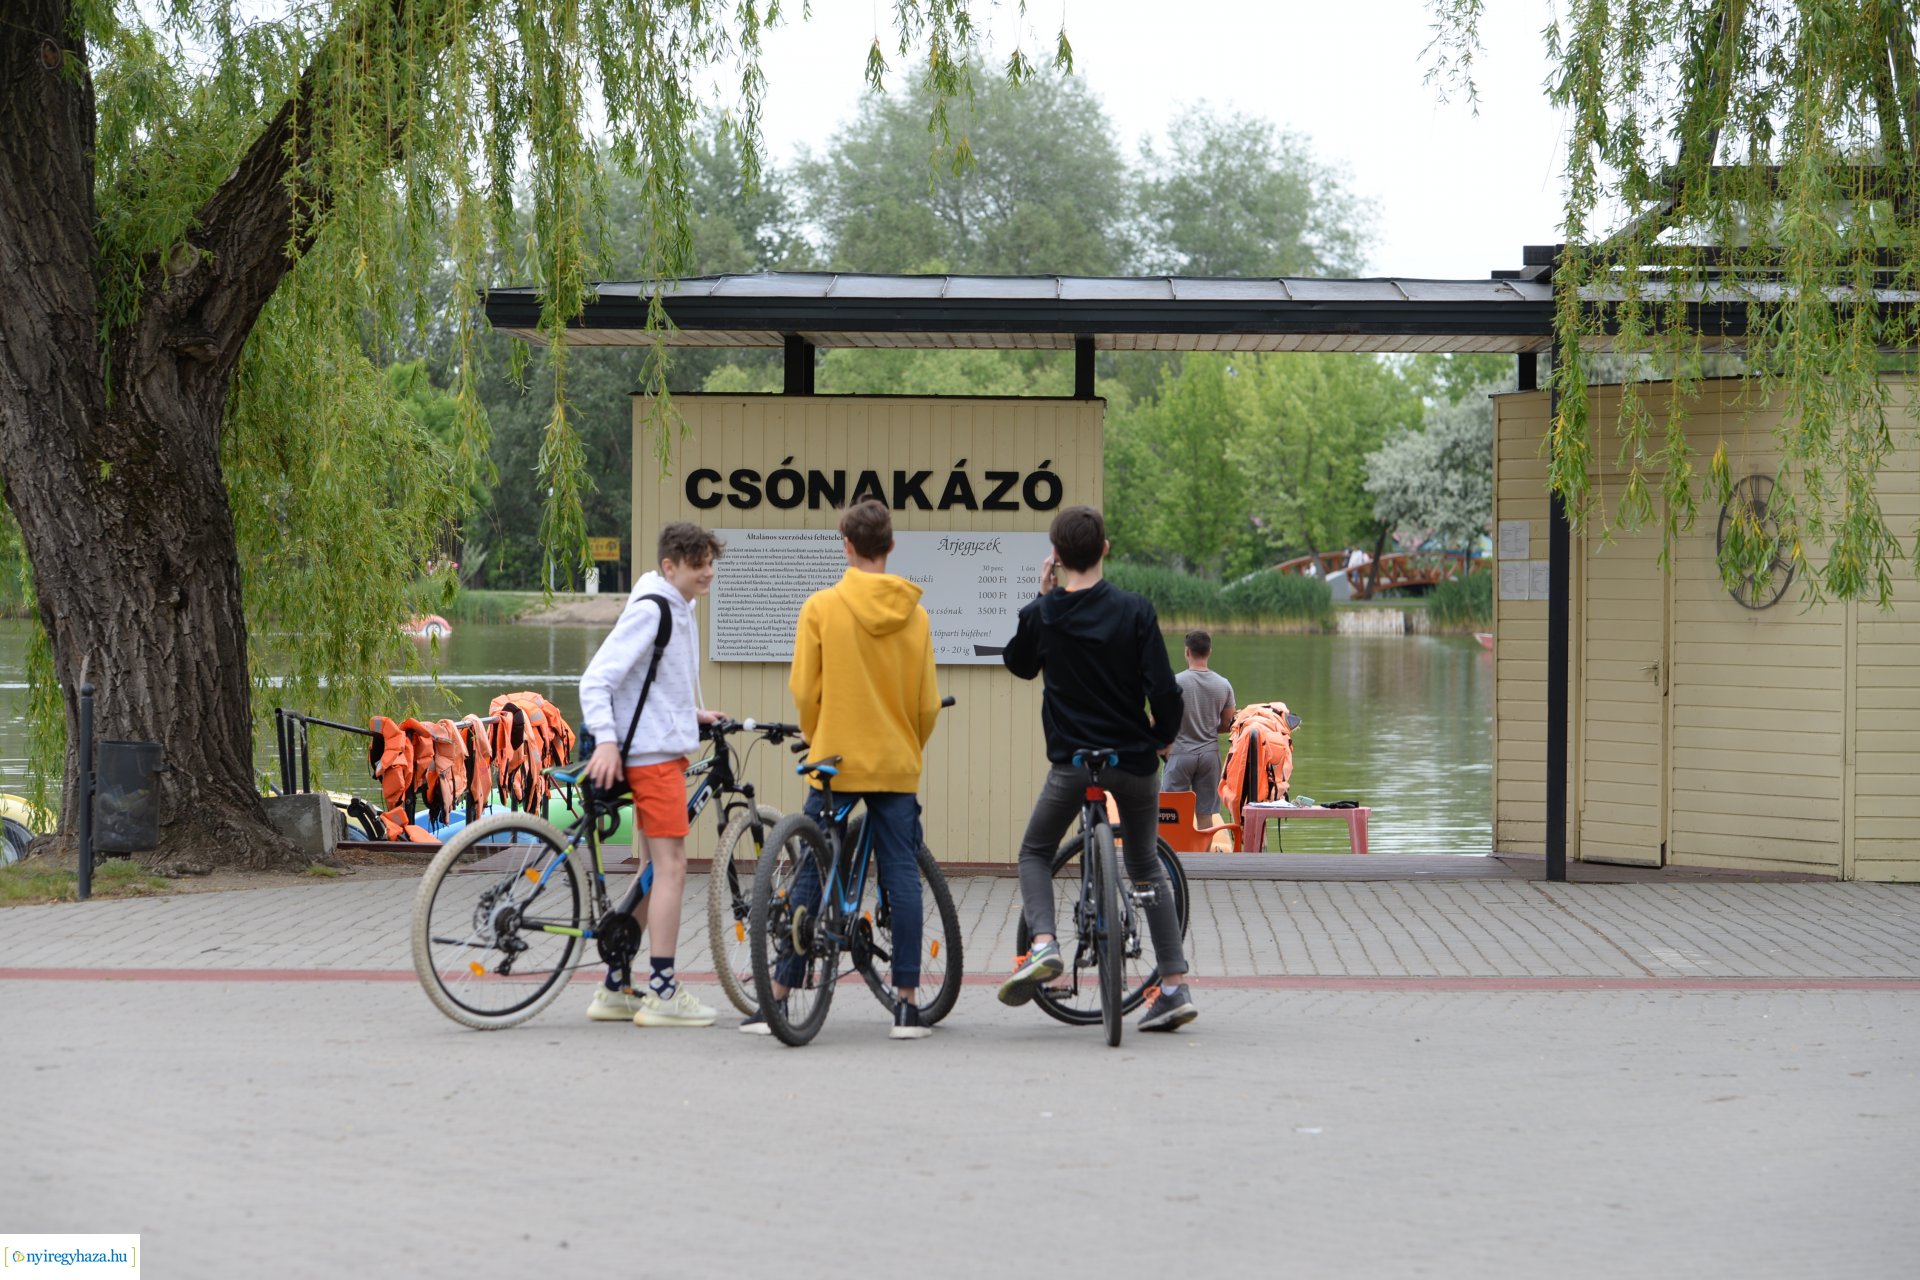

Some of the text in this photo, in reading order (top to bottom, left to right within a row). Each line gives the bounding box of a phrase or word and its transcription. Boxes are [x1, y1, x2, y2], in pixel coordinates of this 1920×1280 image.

[685, 456, 1063, 511] CSÓNAKÁZÓ
[938, 535, 1003, 556] Árjegyzék
[909, 574, 934, 583] bicikli
[978, 575, 1007, 584] 2000 Ft
[1016, 576, 1036, 584] 2500
[978, 591, 1007, 599] 1000 Ft
[1016, 592, 1036, 600] 1300
[936, 606, 963, 615] csónak
[977, 607, 998, 615] 3500
[998, 606, 1007, 615] Ft
[934, 630, 959, 640] tóparti
[940, 646, 946, 654] 9
[952, 646, 962, 654] 20
[963, 646, 970, 656] ig
